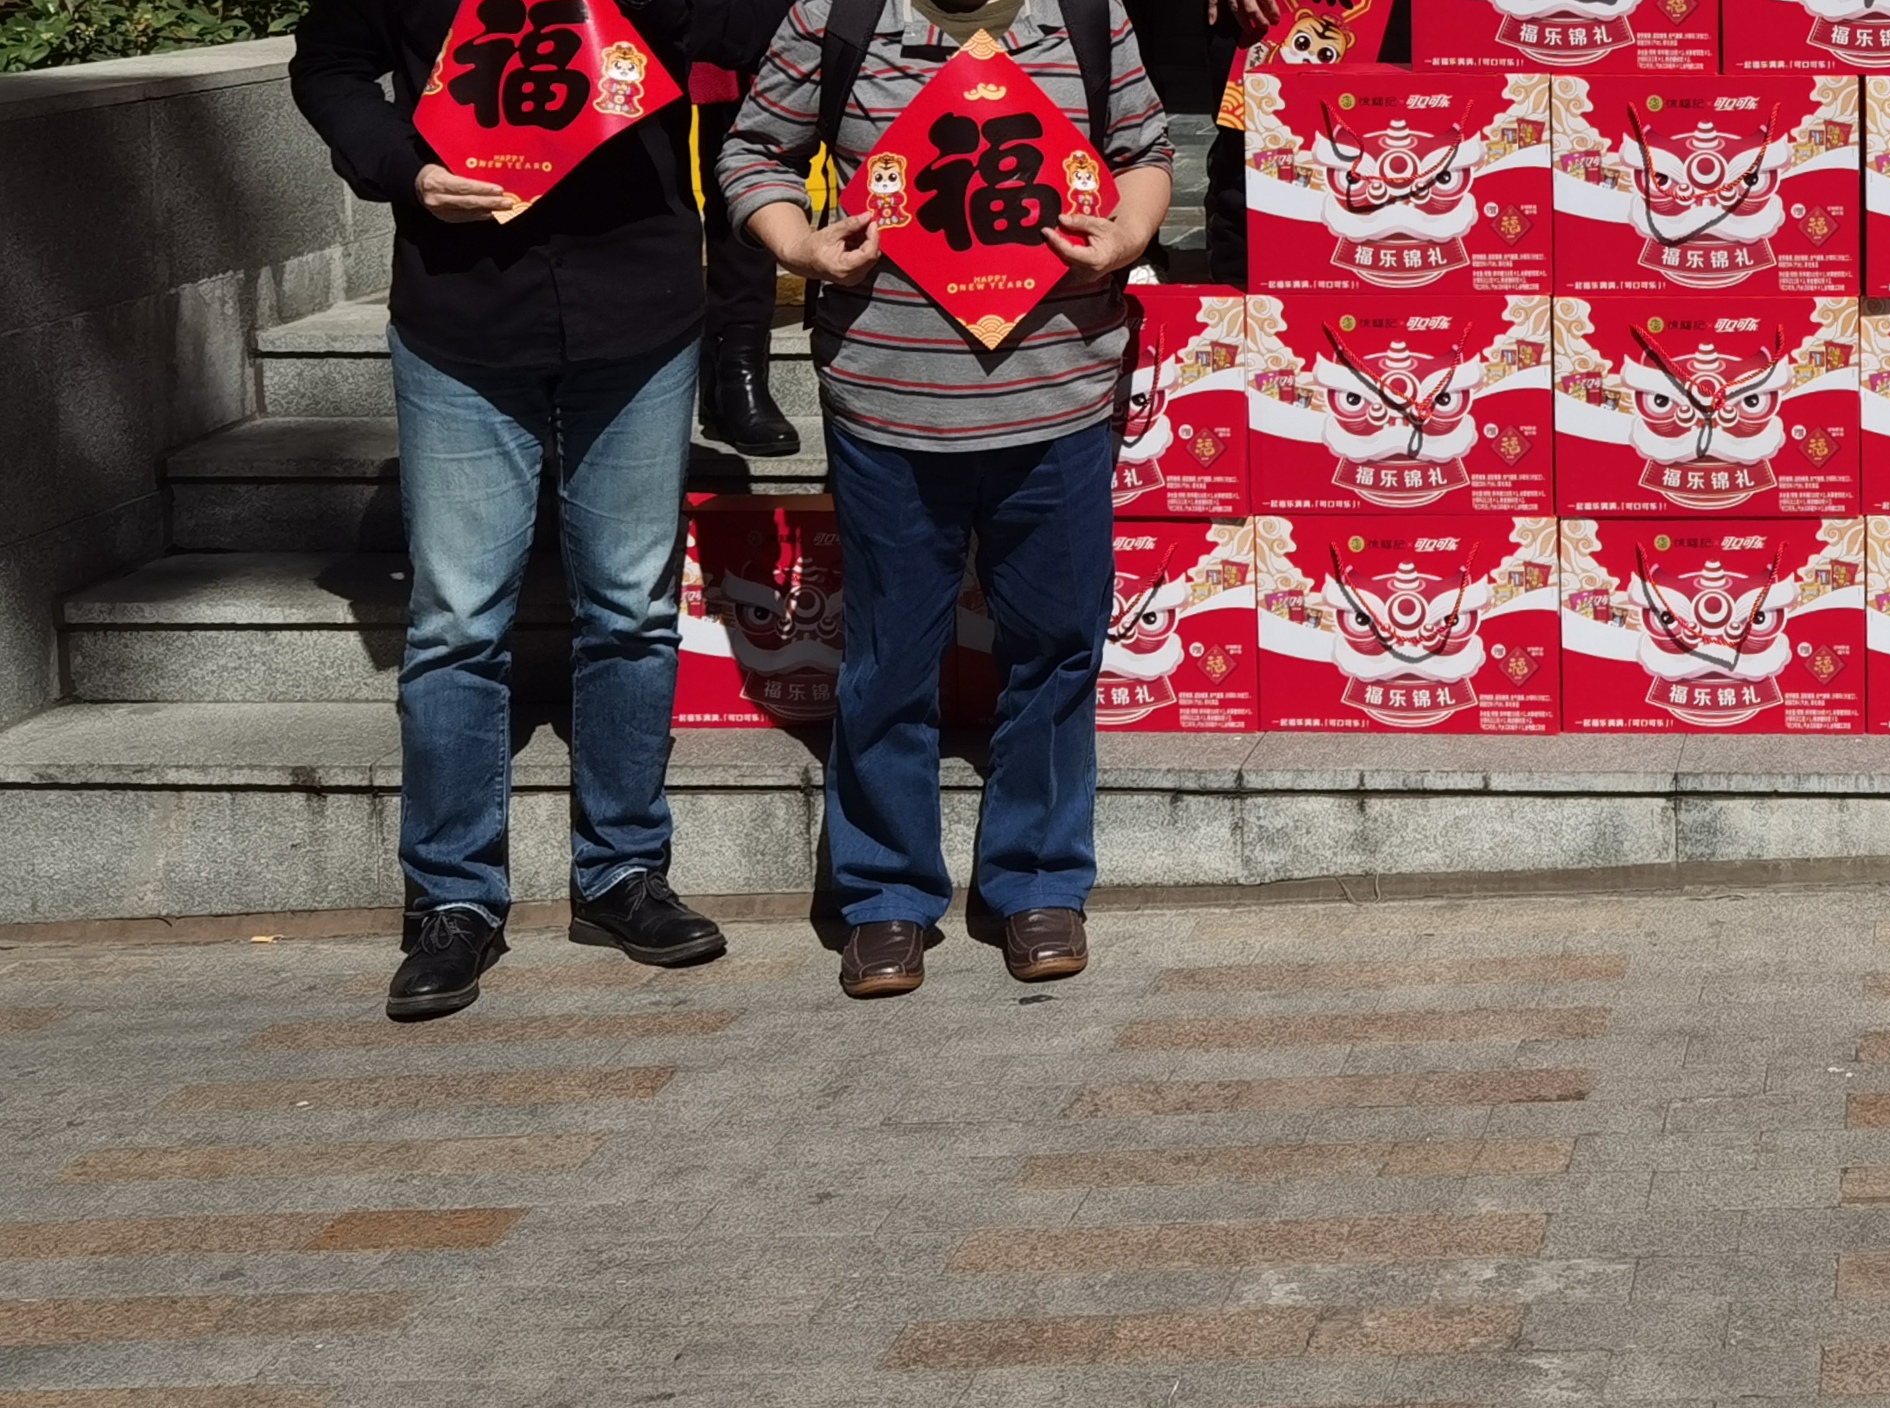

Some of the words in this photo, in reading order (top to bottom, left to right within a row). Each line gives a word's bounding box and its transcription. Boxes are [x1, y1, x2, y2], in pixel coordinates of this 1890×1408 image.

[1519, 23, 1612, 46] 福乐锦礼
[1406, 94, 1452, 109] 可口可乐
[1714, 96, 1760, 111] 可口可乐
[479, 160, 504, 169] NEW
[506, 161, 543, 170] YEAR
[493, 154, 525, 163] HAPPY
[914, 111, 1063, 252] 福
[1354, 246, 1447, 267] 福乐锦礼
[1662, 248, 1754, 268] 福乐锦礼
[959, 281, 986, 291] NEW
[989, 279, 1023, 290] YEAR
[973, 274, 1008, 284] HAPPY
[1406, 316, 1452, 330] 可口可乐
[1714, 318, 1761, 332] 可口可乐
[1356, 466, 1447, 488] 福乐锦礼
[1662, 468, 1754, 488] 福乐锦礼
[1415, 538, 1460, 552] 可口可乐
[1721, 536, 1767, 550] 可口可乐
[763, 678, 831, 702] 福乐锦
[1096, 685, 1154, 704] 乐锦礼
[1364, 685, 1456, 708] 福乐锦礼
[1669, 684, 1761, 706] 福乐锦礼
